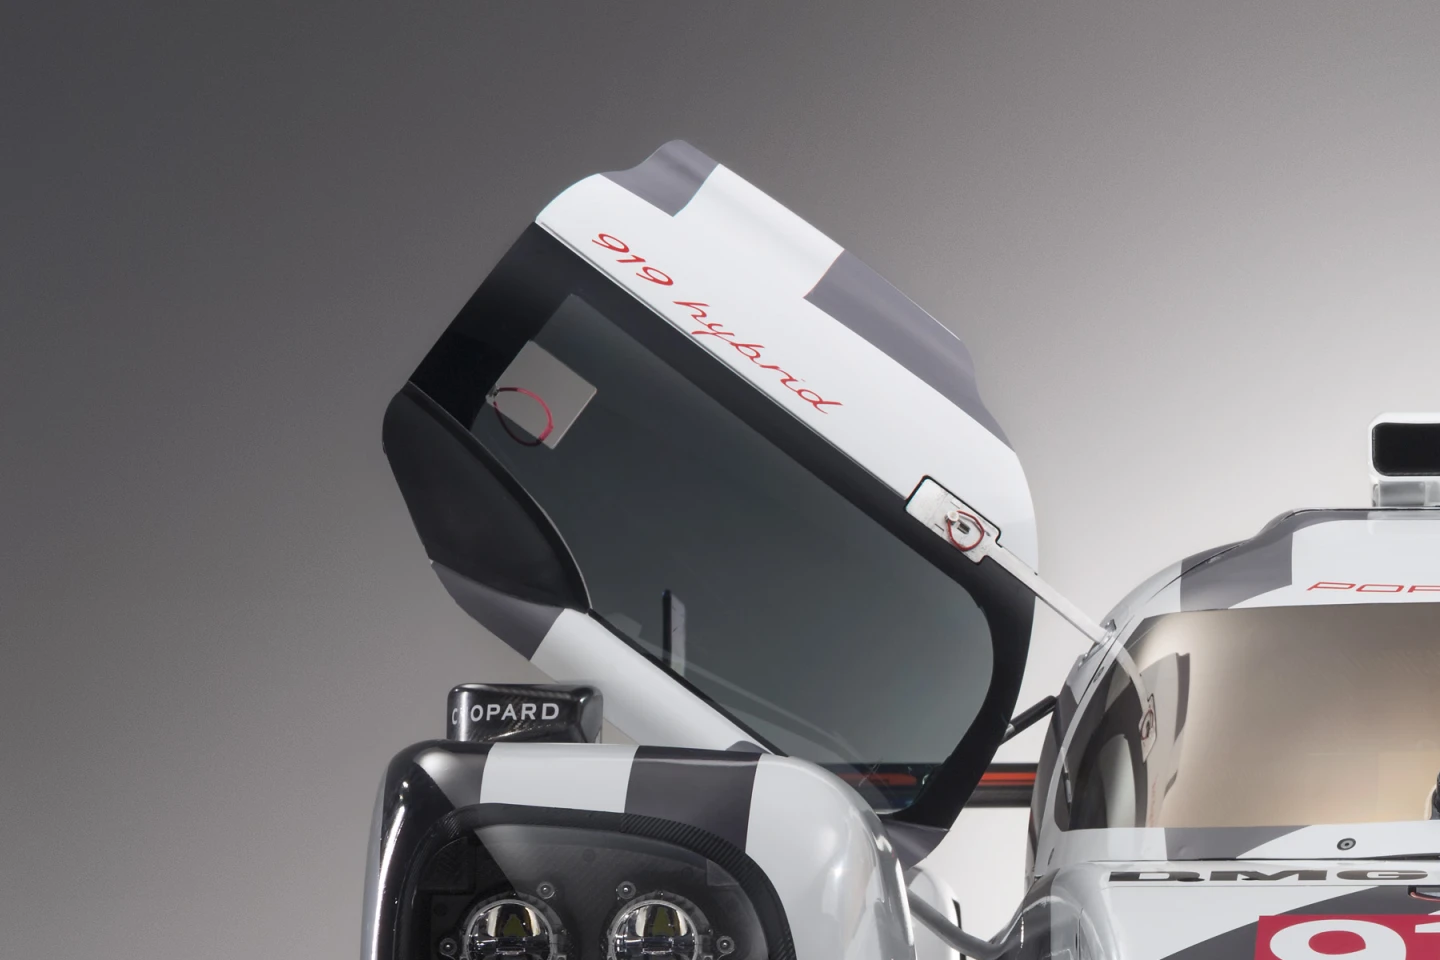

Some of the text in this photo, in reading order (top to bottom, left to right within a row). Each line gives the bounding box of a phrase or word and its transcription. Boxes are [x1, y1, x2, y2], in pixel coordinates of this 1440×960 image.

[591, 233, 843, 415] 919 hybrid
[451, 702, 560, 726] COPARD
[1108, 869, 1429, 883] DMG
